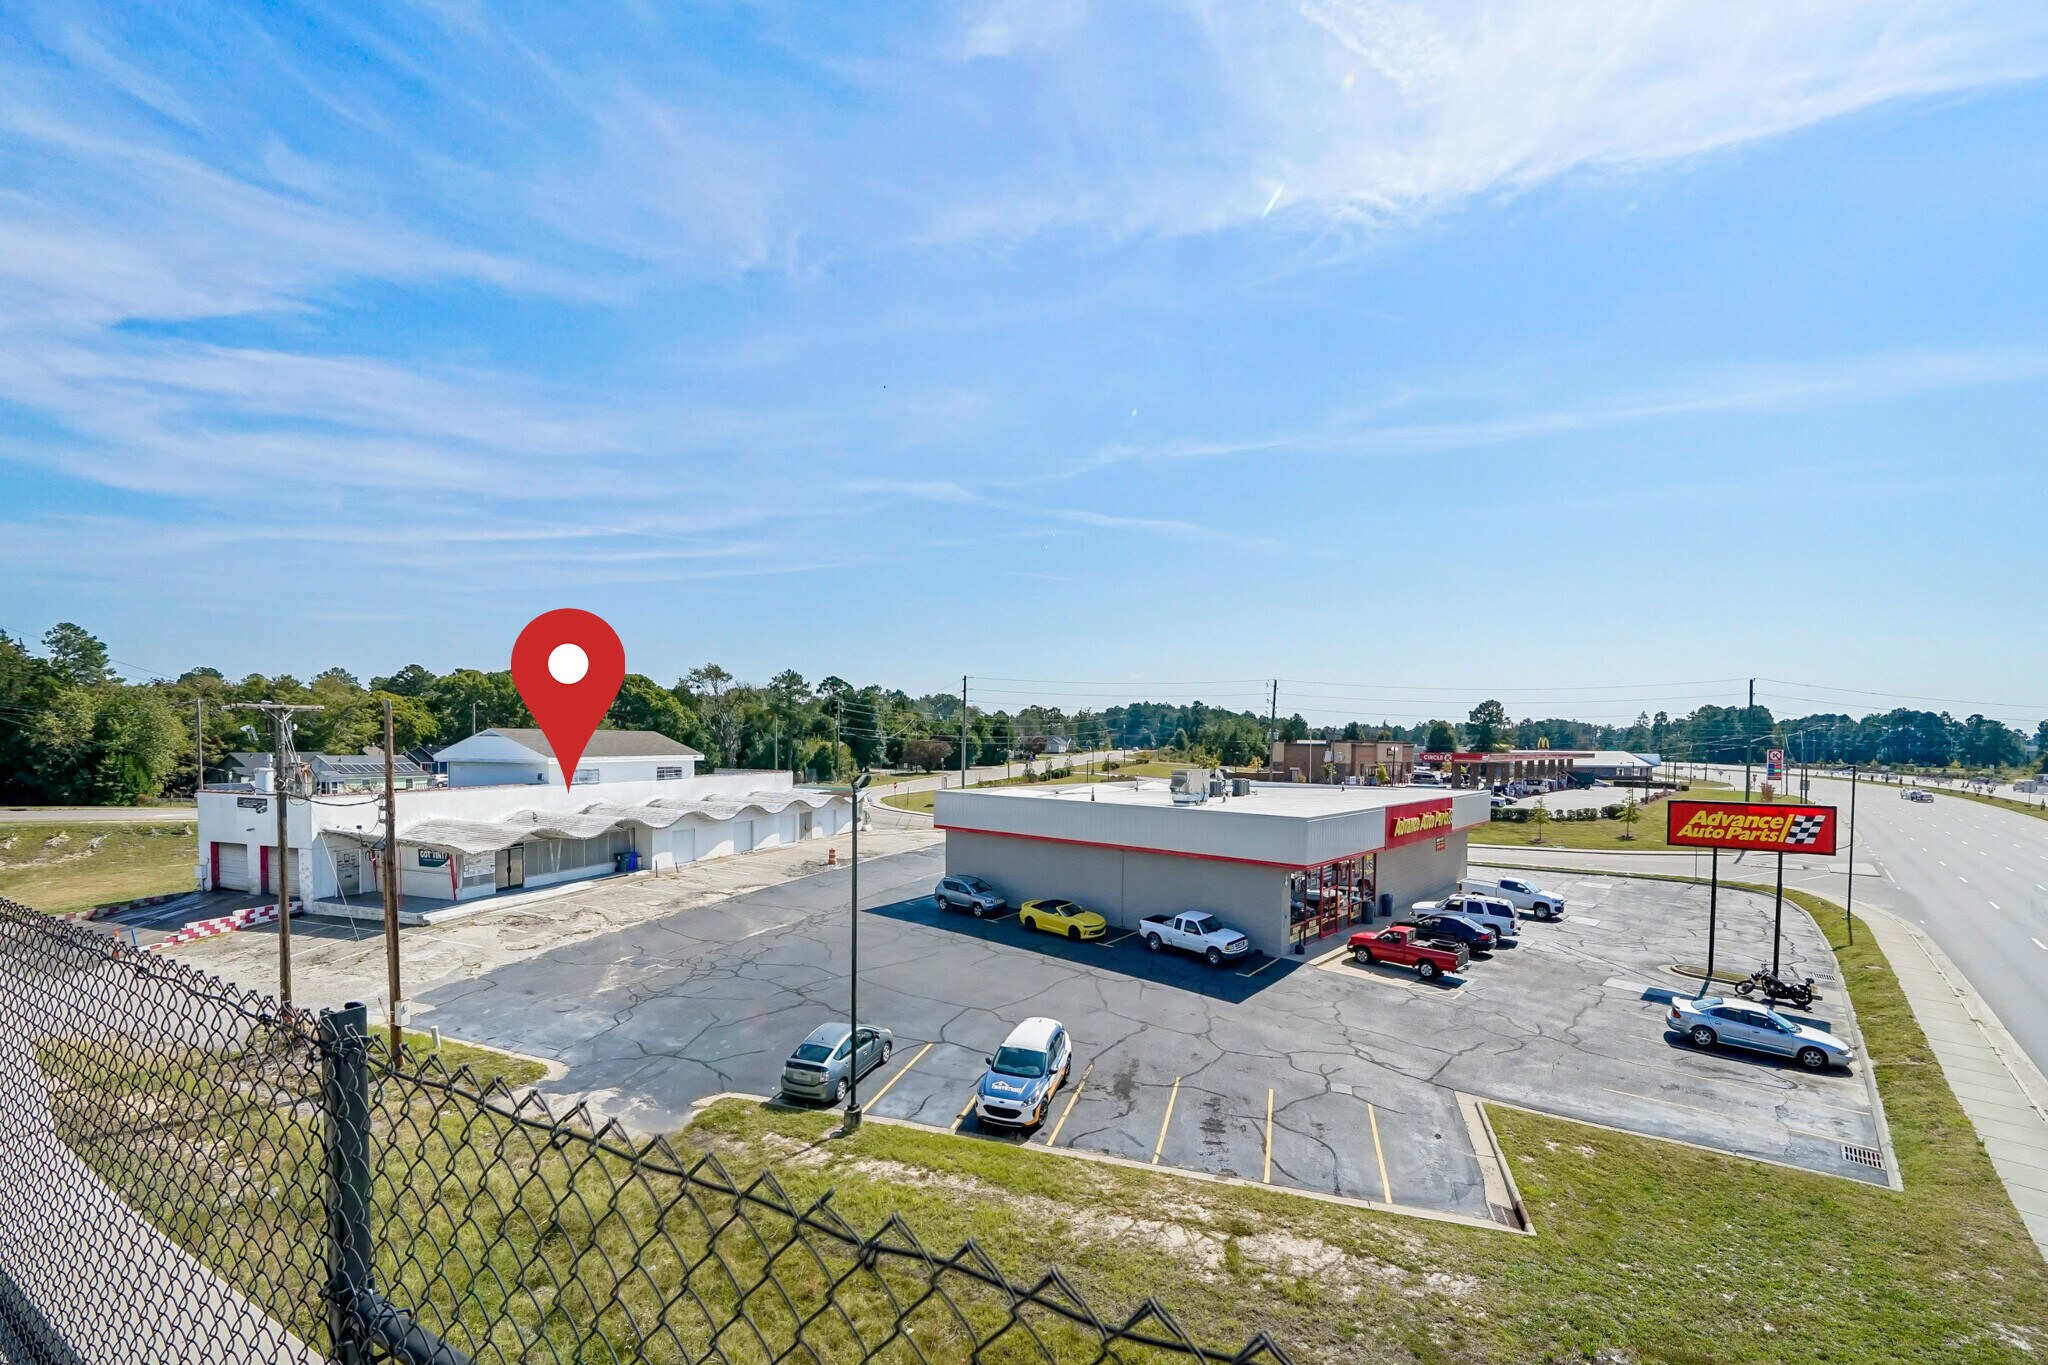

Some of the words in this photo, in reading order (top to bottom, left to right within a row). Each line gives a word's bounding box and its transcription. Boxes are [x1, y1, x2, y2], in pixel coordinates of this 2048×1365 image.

[1688, 810, 1784, 829] Advance
[1677, 824, 1725, 838] Auto
[1725, 826, 1779, 843] Parts
[419, 850, 431, 859] GOT
